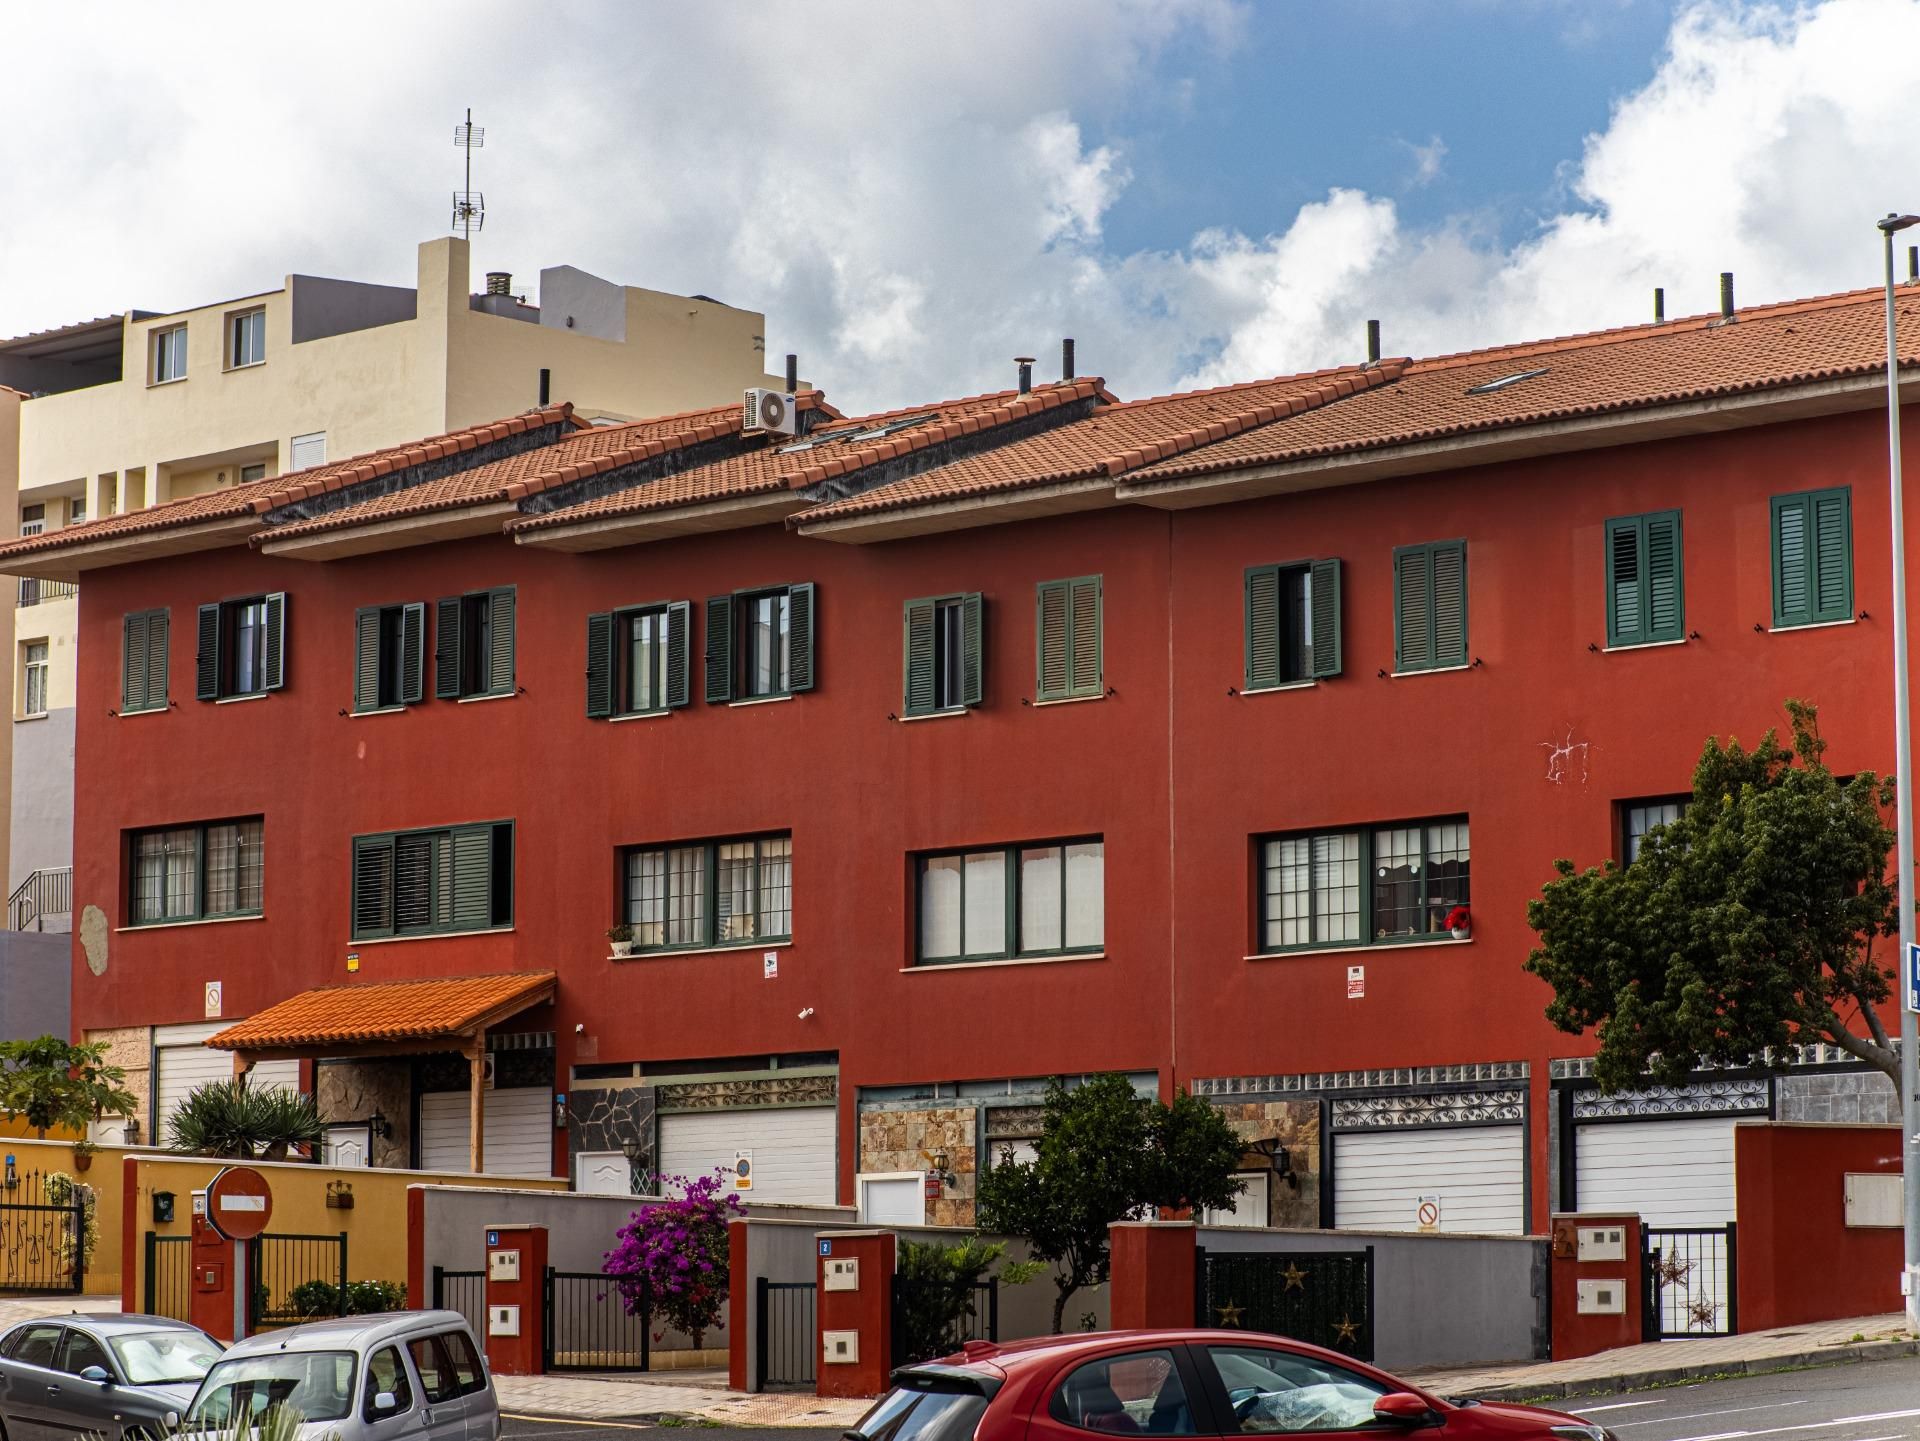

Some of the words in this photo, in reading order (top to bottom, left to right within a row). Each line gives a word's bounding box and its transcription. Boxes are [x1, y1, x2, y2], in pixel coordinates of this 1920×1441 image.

[490, 1234, 495, 1242] 4
[1558, 1228, 1567, 1243] 2
[823, 1243, 828, 1252] 2
[1564, 1241, 1575, 1255] A
